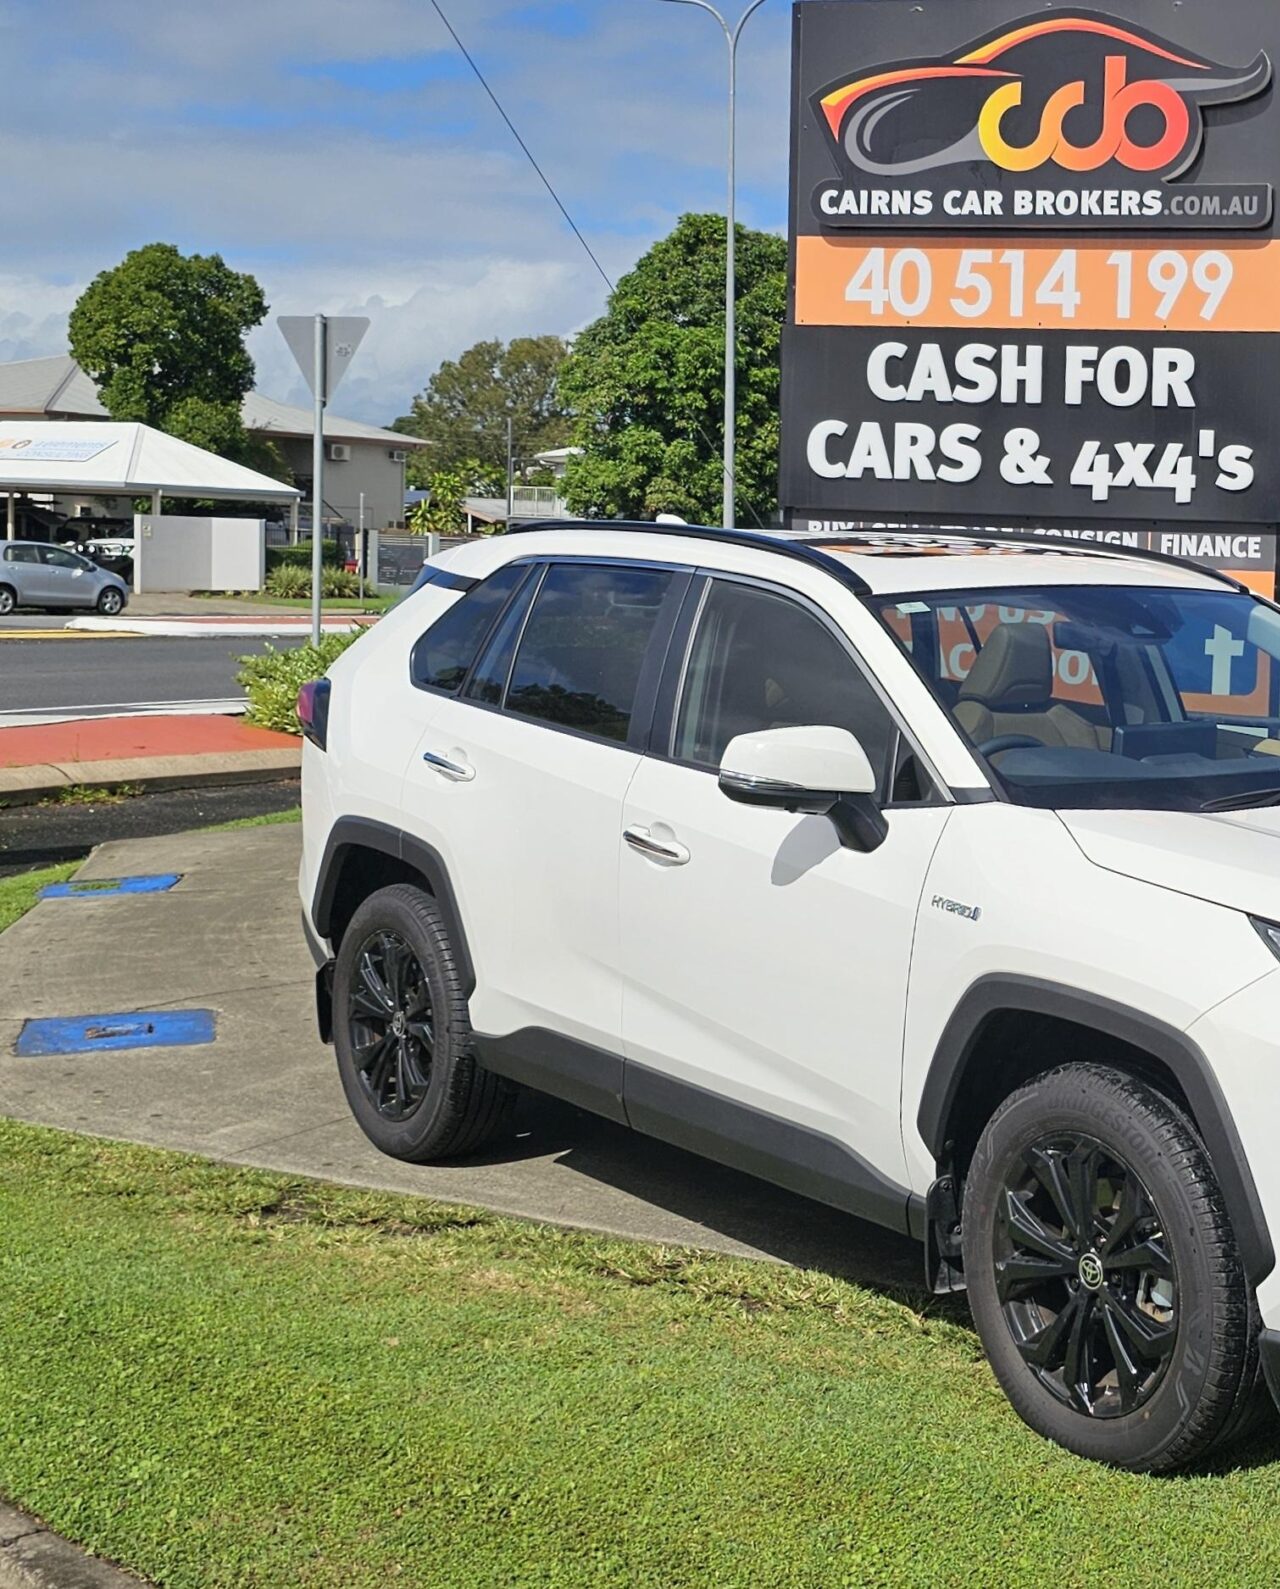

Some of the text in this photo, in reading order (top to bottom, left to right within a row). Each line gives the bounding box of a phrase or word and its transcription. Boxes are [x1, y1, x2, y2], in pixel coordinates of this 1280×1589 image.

[819, 189, 933, 216] CAIRNS
[943, 190, 1003, 216] CAR
[845, 247, 1233, 321] 40 514 199
[866, 341, 1197, 408] CASH FOR
[806, 419, 983, 483] CARS
[999, 427, 1054, 486] &
[1160, 532, 1262, 559] FINANCE
